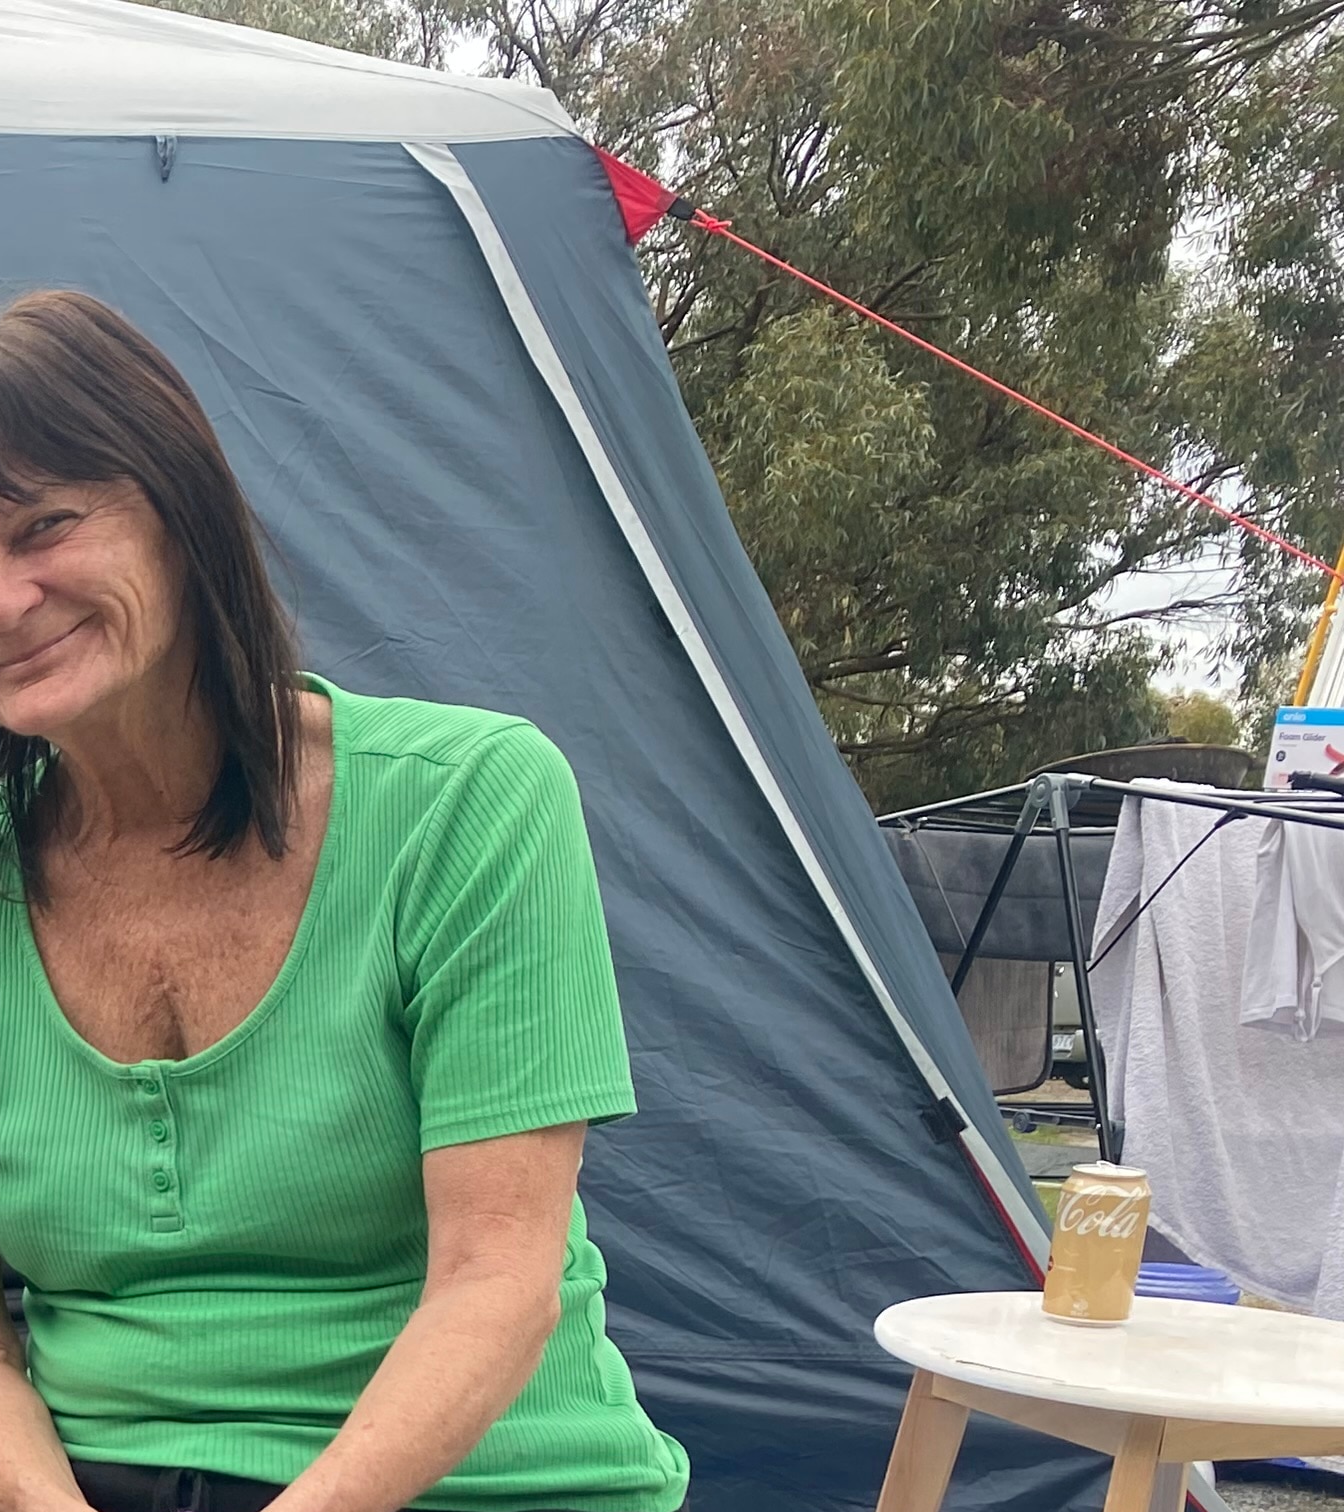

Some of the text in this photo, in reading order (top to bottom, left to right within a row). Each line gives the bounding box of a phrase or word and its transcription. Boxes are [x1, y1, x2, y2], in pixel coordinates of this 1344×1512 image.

[1278, 732, 1326, 741] Foam Glider
[1060, 1185, 1146, 1238] Cola
